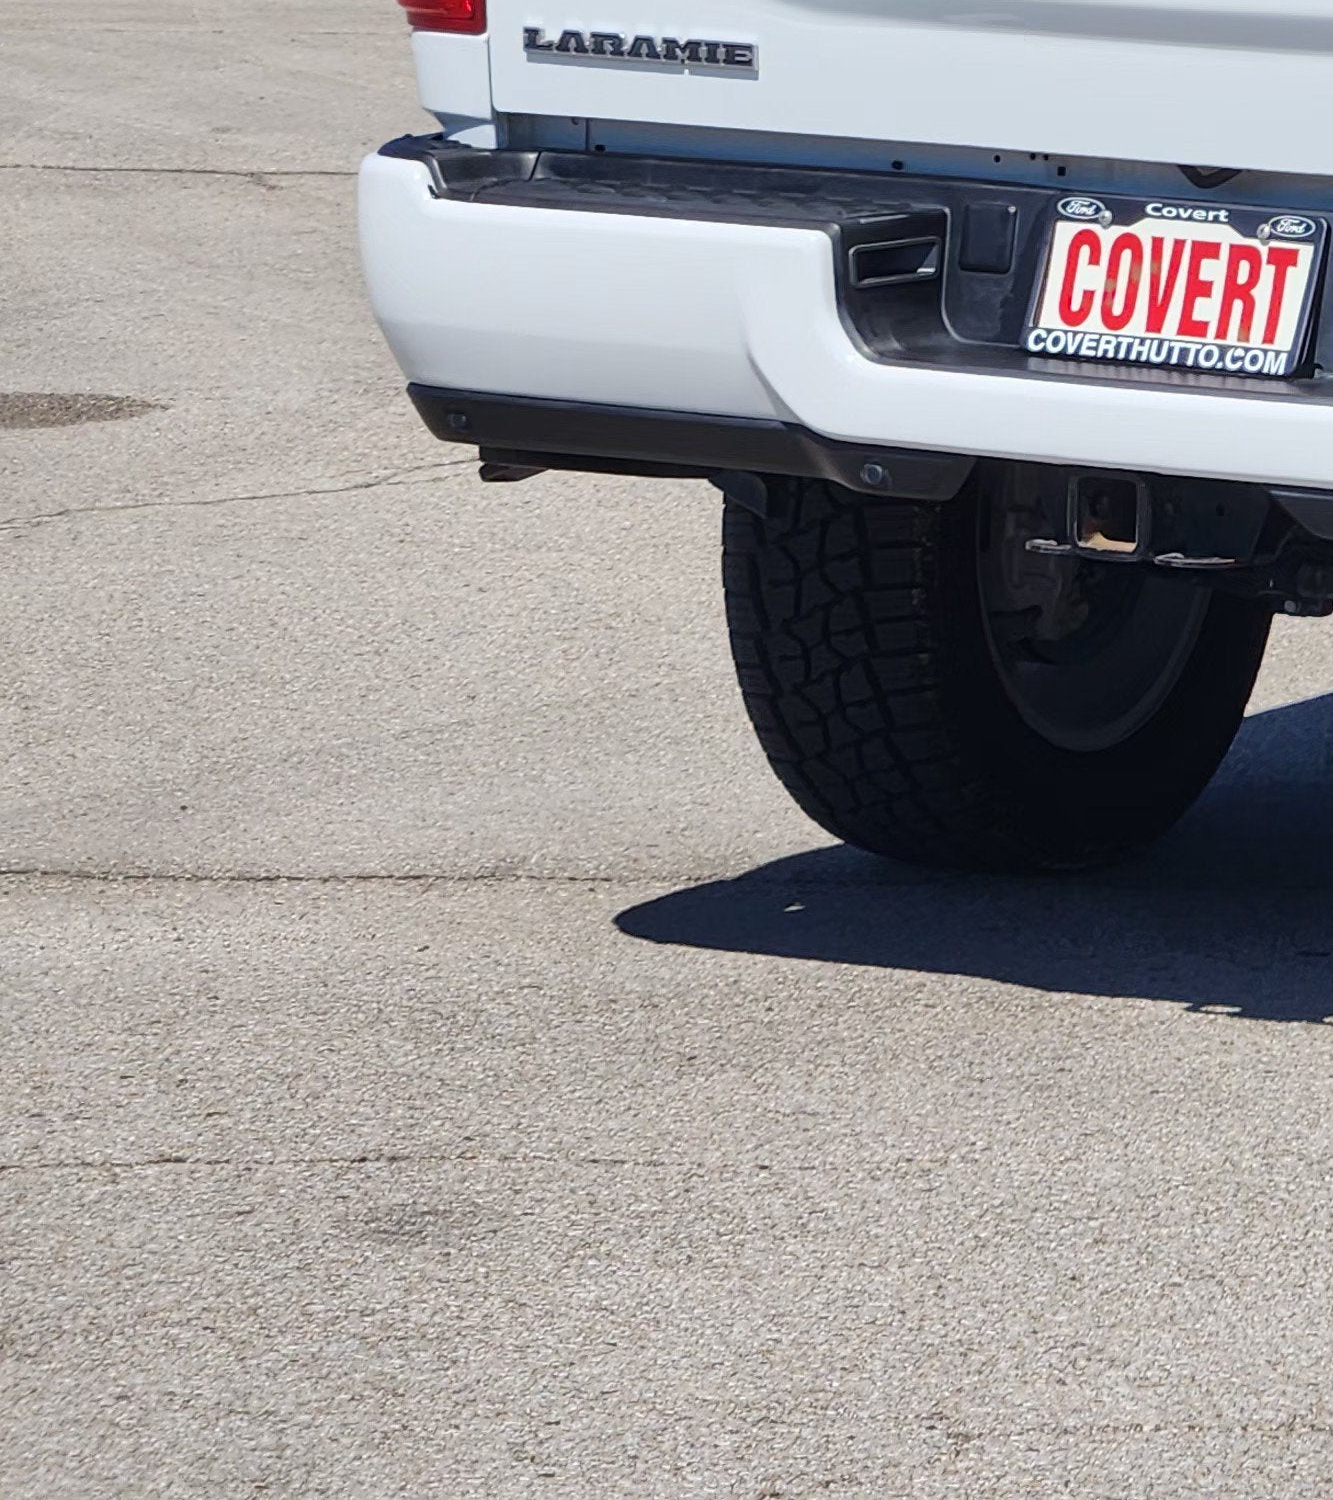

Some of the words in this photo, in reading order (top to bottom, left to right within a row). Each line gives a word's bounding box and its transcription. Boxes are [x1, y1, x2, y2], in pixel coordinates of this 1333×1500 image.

[523, 26, 759, 69] LARAMIE
[1065, 200, 1098, 215] Ford
[1145, 203, 1230, 222] Covert
[1276, 218, 1307, 234] Ford
[1058, 228, 1300, 346] COVERT
[1027, 328, 1288, 376] COVERTHUTTO.COM
